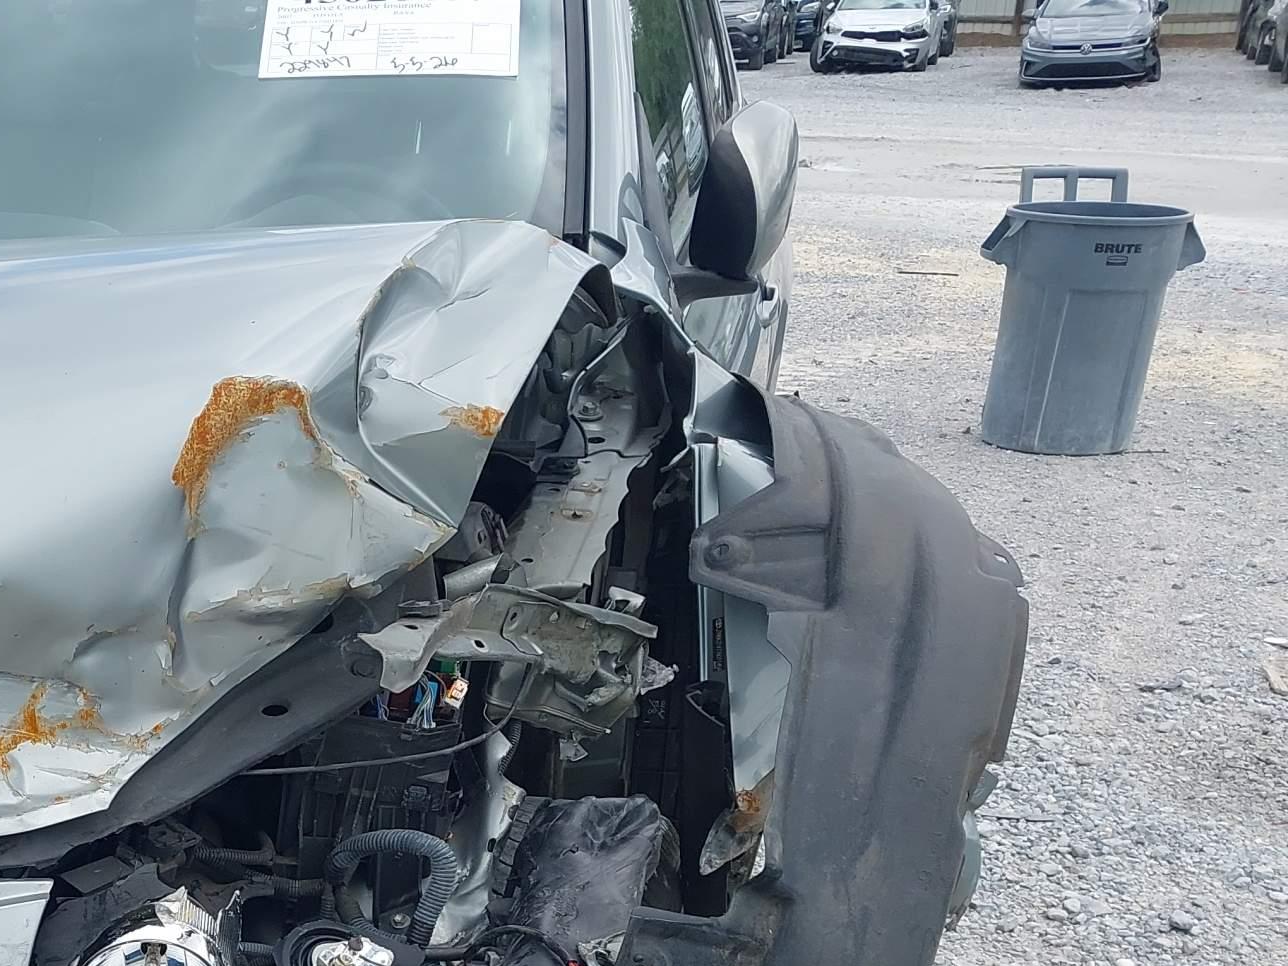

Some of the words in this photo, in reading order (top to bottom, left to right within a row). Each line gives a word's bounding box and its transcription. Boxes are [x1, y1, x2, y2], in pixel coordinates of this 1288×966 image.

[277, 5, 334, 14] Progressive
[337, 3, 379, 11] Casualty
[1094, 242, 1144, 254] BRUTE
